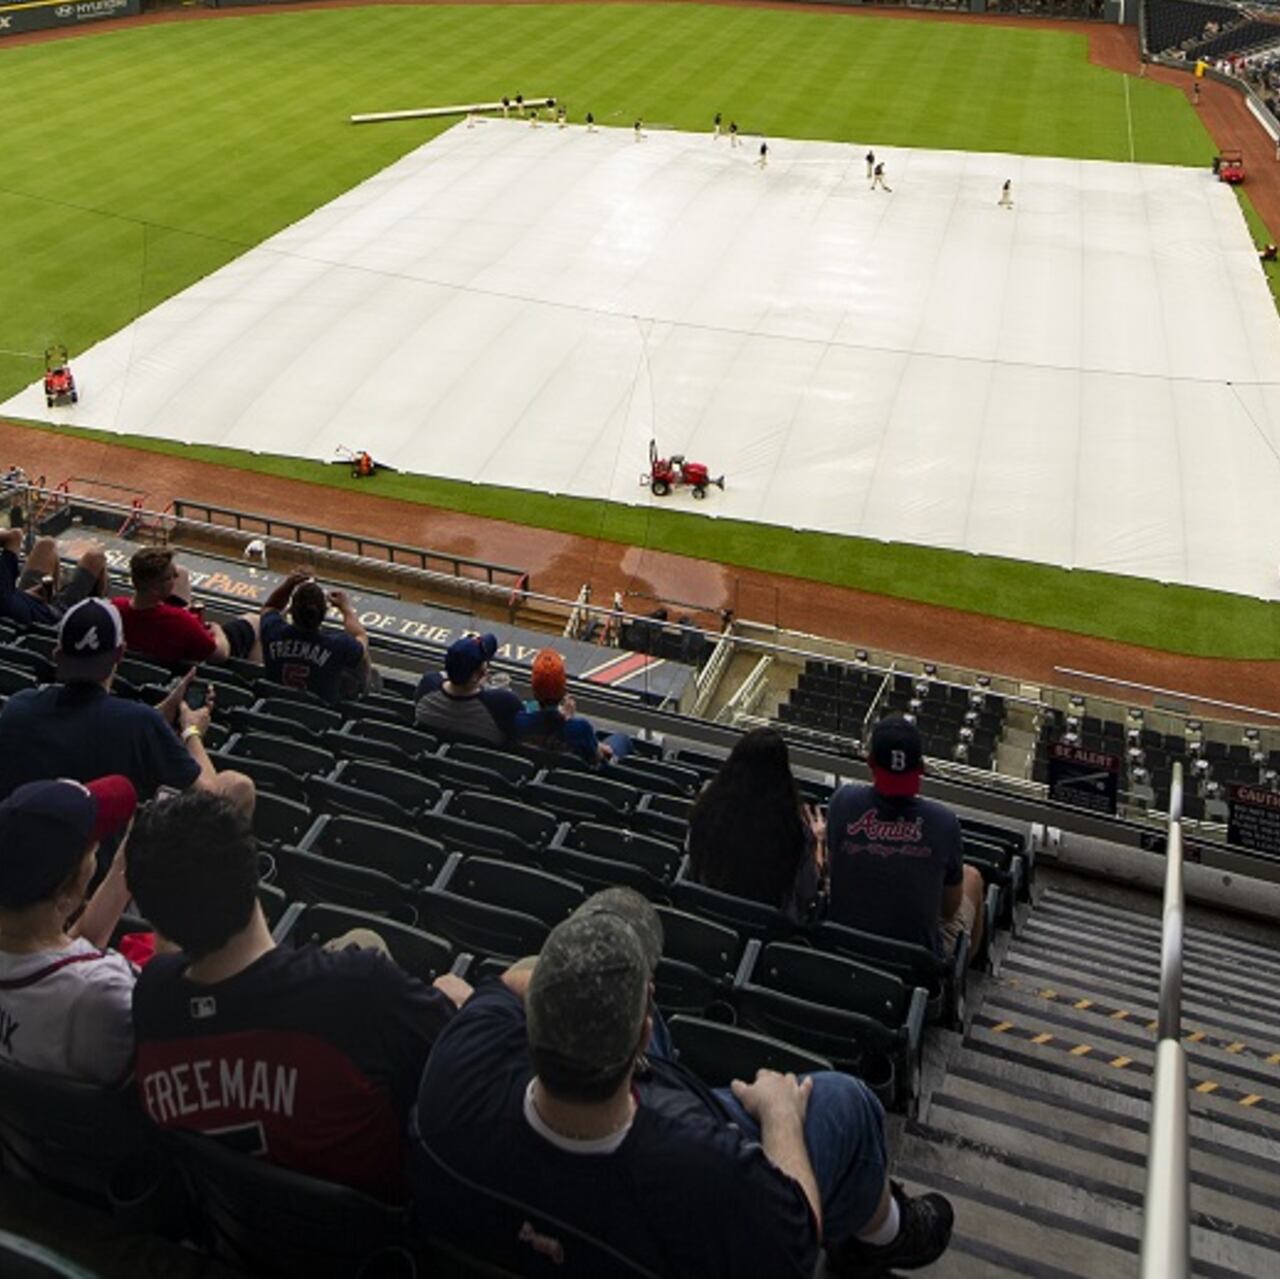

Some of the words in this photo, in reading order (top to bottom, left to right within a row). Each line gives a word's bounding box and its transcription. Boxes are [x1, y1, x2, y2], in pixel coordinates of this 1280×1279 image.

[206, 571, 267, 599] PARK
[358, 609, 397, 633] OF
[400, 618, 451, 643] THE
[270, 639, 332, 666] FREEMAN
[891, 750, 906, 772] B
[144, 1058, 298, 1123] FREEMAN
